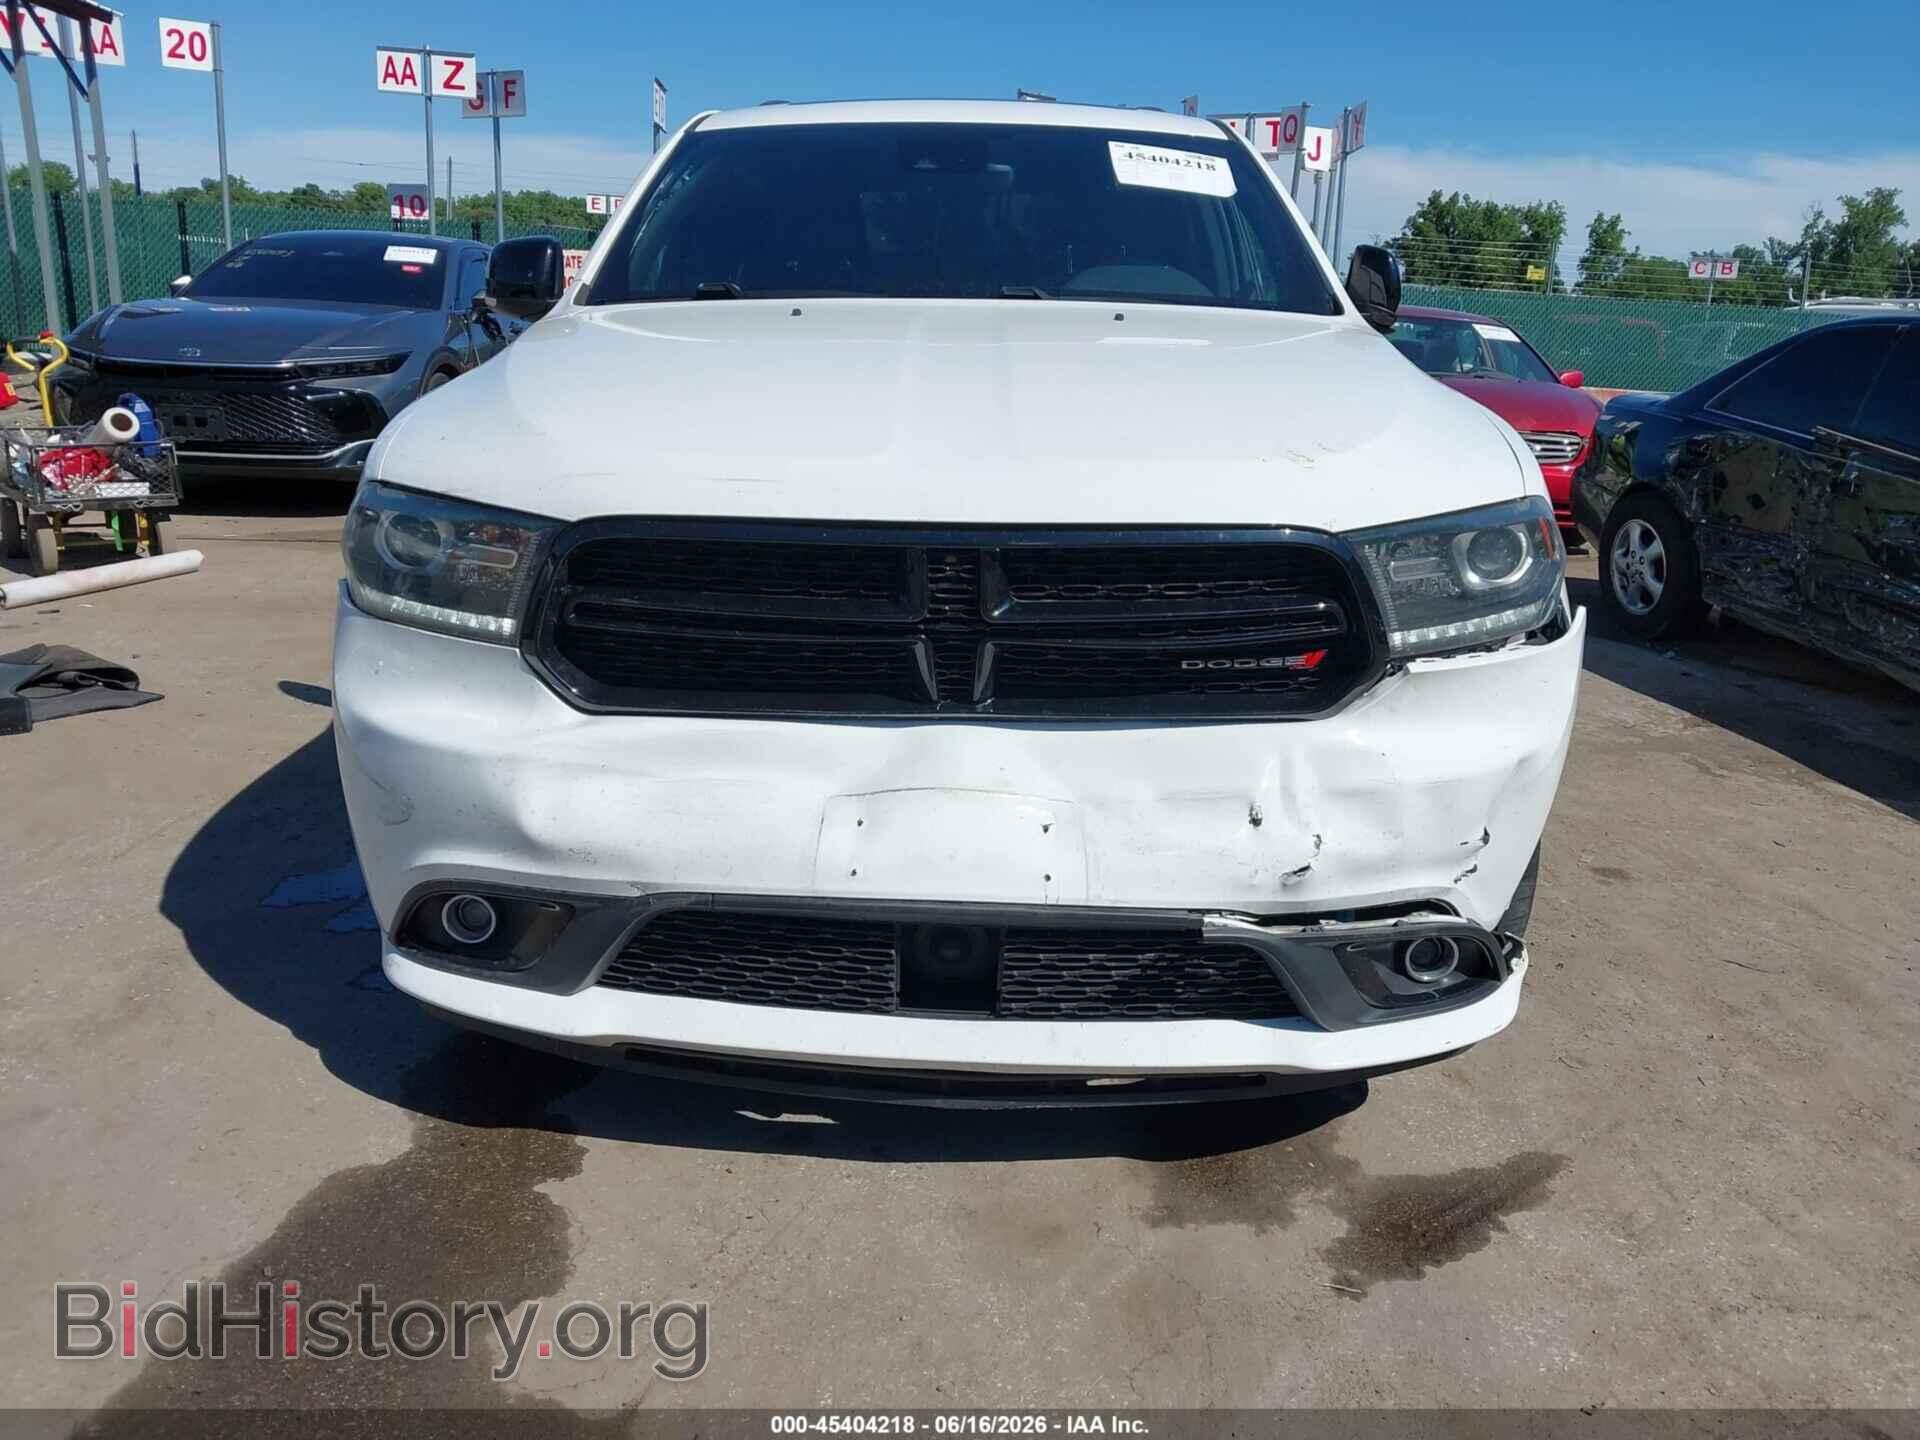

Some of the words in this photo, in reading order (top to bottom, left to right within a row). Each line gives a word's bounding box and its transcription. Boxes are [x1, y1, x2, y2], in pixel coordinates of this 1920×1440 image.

[165, 28, 207, 62] 20
[382, 55, 418, 86] AA
[443, 60, 466, 91] Z
[503, 79, 518, 108] F
[1265, 120, 1281, 147] T
[1283, 114, 1298, 144] Q
[1307, 136, 1322, 161] J
[1123, 151, 1217, 172] 45404218
[393, 194, 426, 217] 10
[591, 197, 602, 210] E
[1695, 262, 1706, 274] C
[1721, 262, 1733, 275] B
[1181, 655, 1307, 670] DODGE
